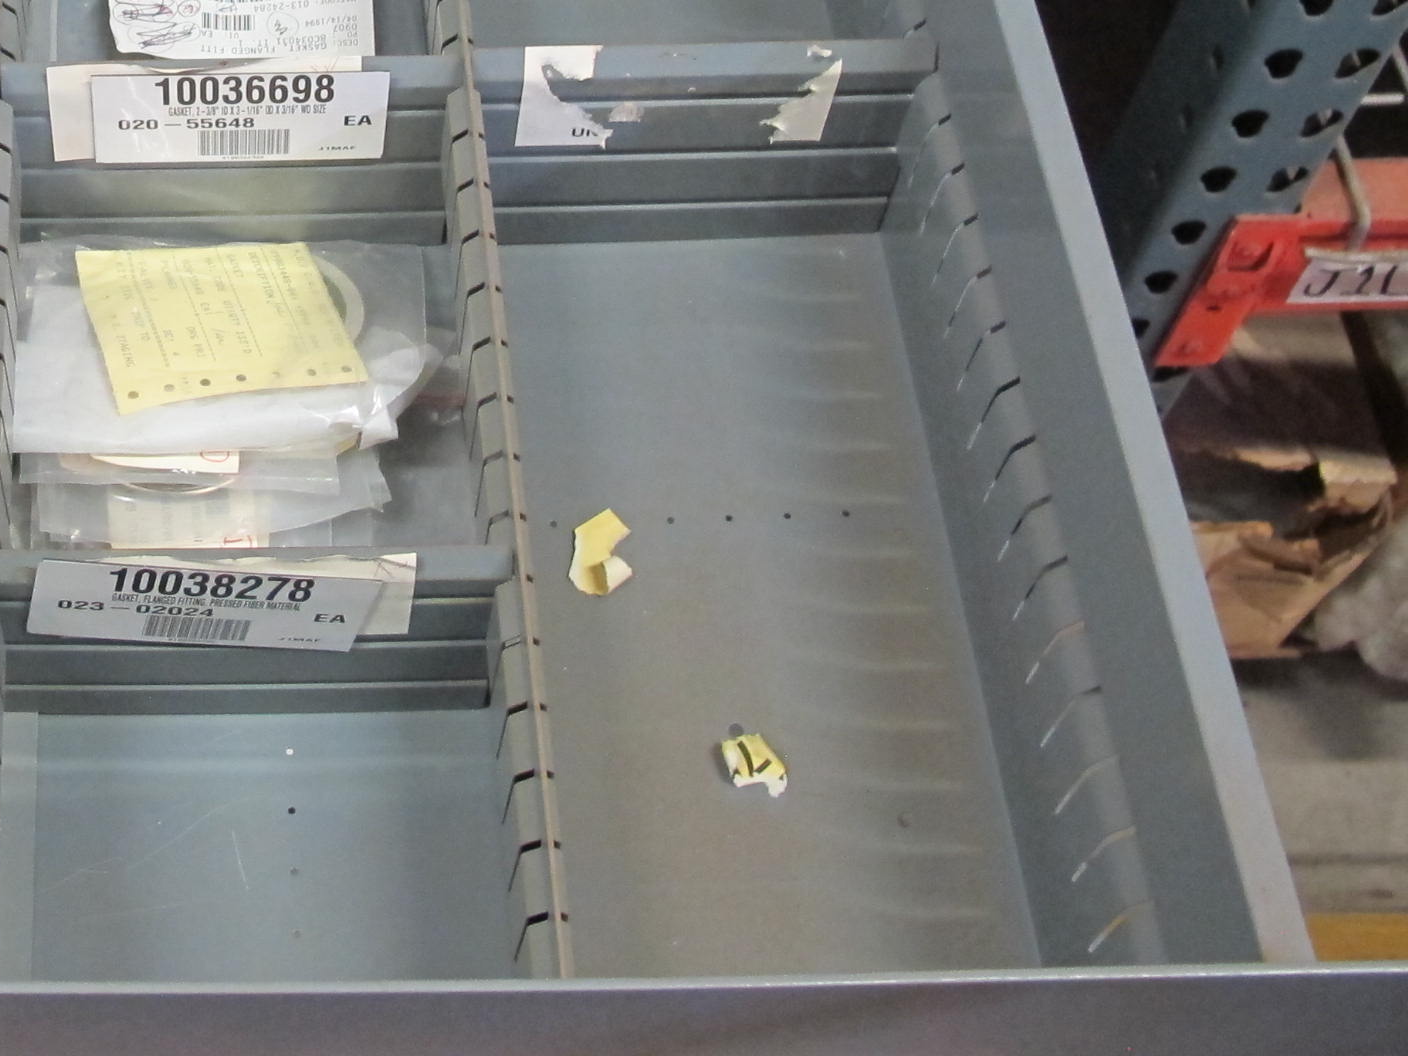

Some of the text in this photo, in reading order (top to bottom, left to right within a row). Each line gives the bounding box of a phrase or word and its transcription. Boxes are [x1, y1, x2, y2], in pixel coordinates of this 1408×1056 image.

[154, 74, 335, 106] 10036698
[343, 115, 372, 127] EA
[109, 567, 315, 603] 10038278
[313, 613, 346, 624] EA
